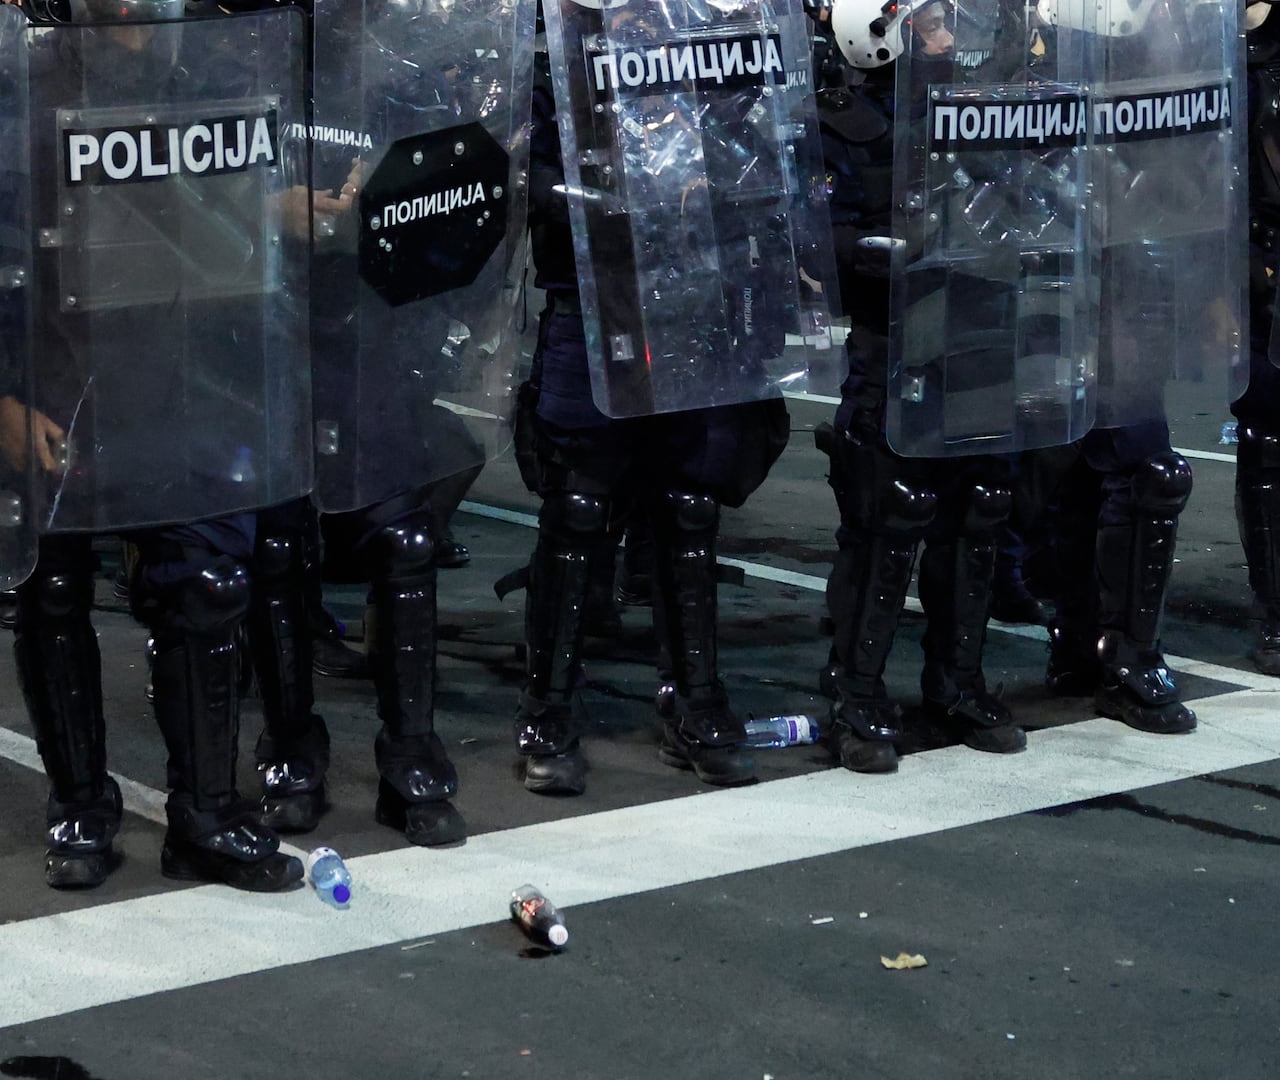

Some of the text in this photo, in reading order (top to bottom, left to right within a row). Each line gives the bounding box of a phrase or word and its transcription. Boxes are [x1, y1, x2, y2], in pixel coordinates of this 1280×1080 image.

[593, 38, 784, 92] ПОЛИЦИЈА
[934, 101, 1087, 143] ПОЛИЦИЈА
[1094, 88, 1231, 134] ПОЛИЦИЈА
[69, 116, 275, 181] POLICIJA
[383, 182, 486, 228] ПОЛИЦИЈА
